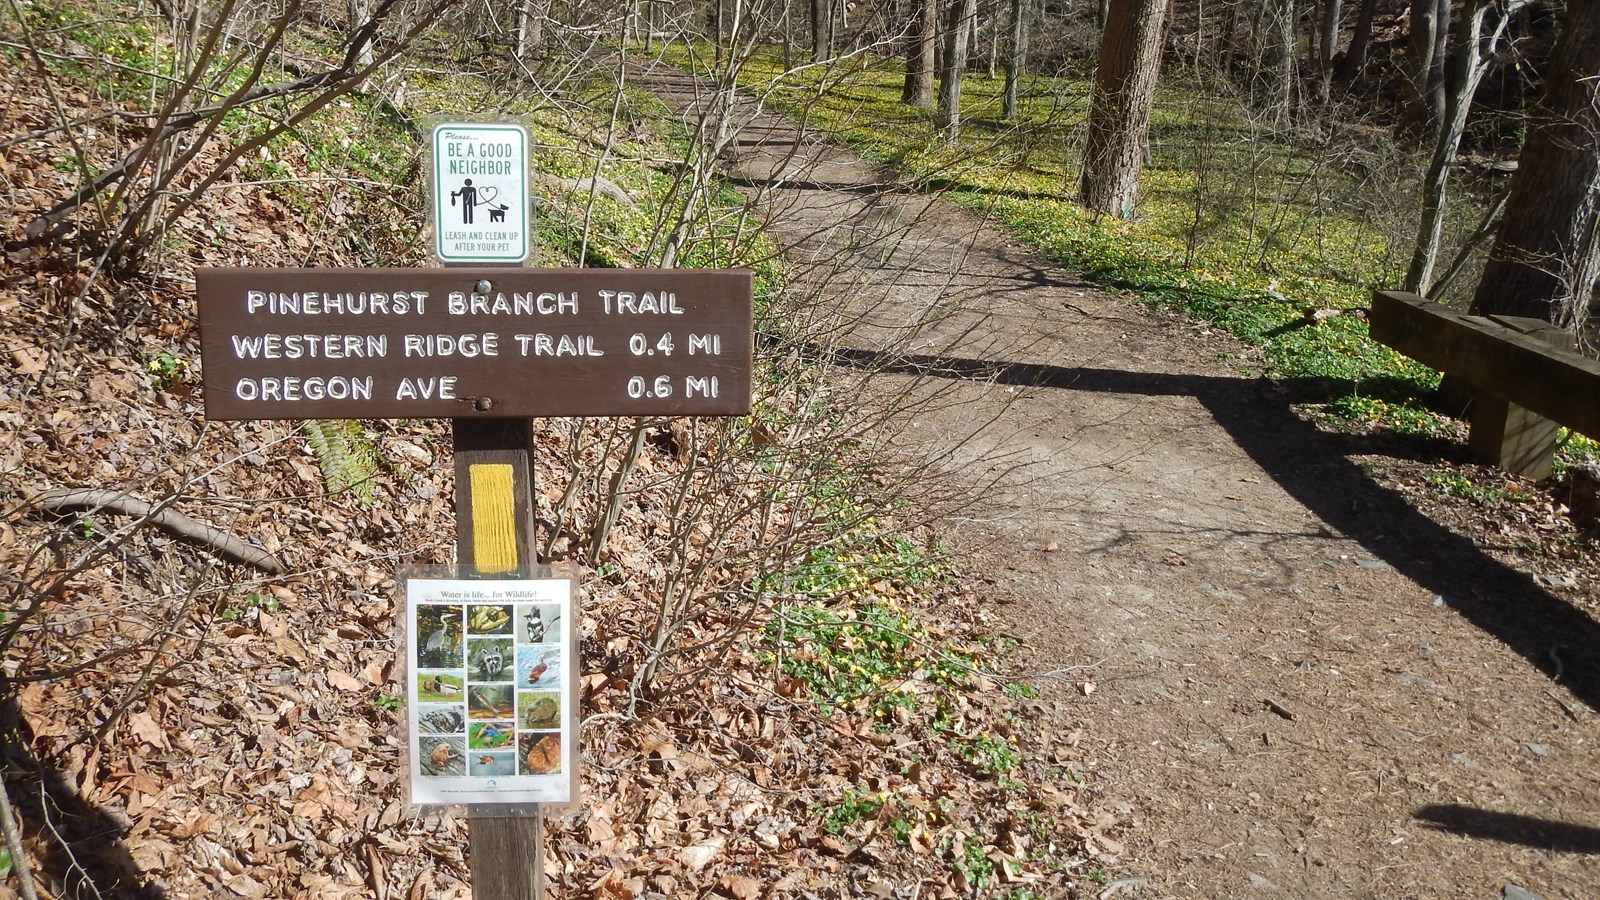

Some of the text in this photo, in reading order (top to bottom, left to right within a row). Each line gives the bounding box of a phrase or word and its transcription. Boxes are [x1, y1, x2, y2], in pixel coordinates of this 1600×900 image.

[448, 143, 512, 158] BE A GOOD
[450, 160, 512, 175] NEIGHBOR
[445, 231, 519, 240] LEASH AND CLEAN UP
[454, 242, 509, 252] AFTER YOUR PET
[247, 289, 685, 315] PINEHURST BRANCH TRAIL
[231, 331, 721, 359] WESTERN RIDGE TRAIL 0.4 MI
[235, 374, 719, 401] OREGON AVE 0.6 MI
[463, 590, 470, 598] is
[492, 590, 503, 598] for
[504, 590, 537, 598] Wildlife!
